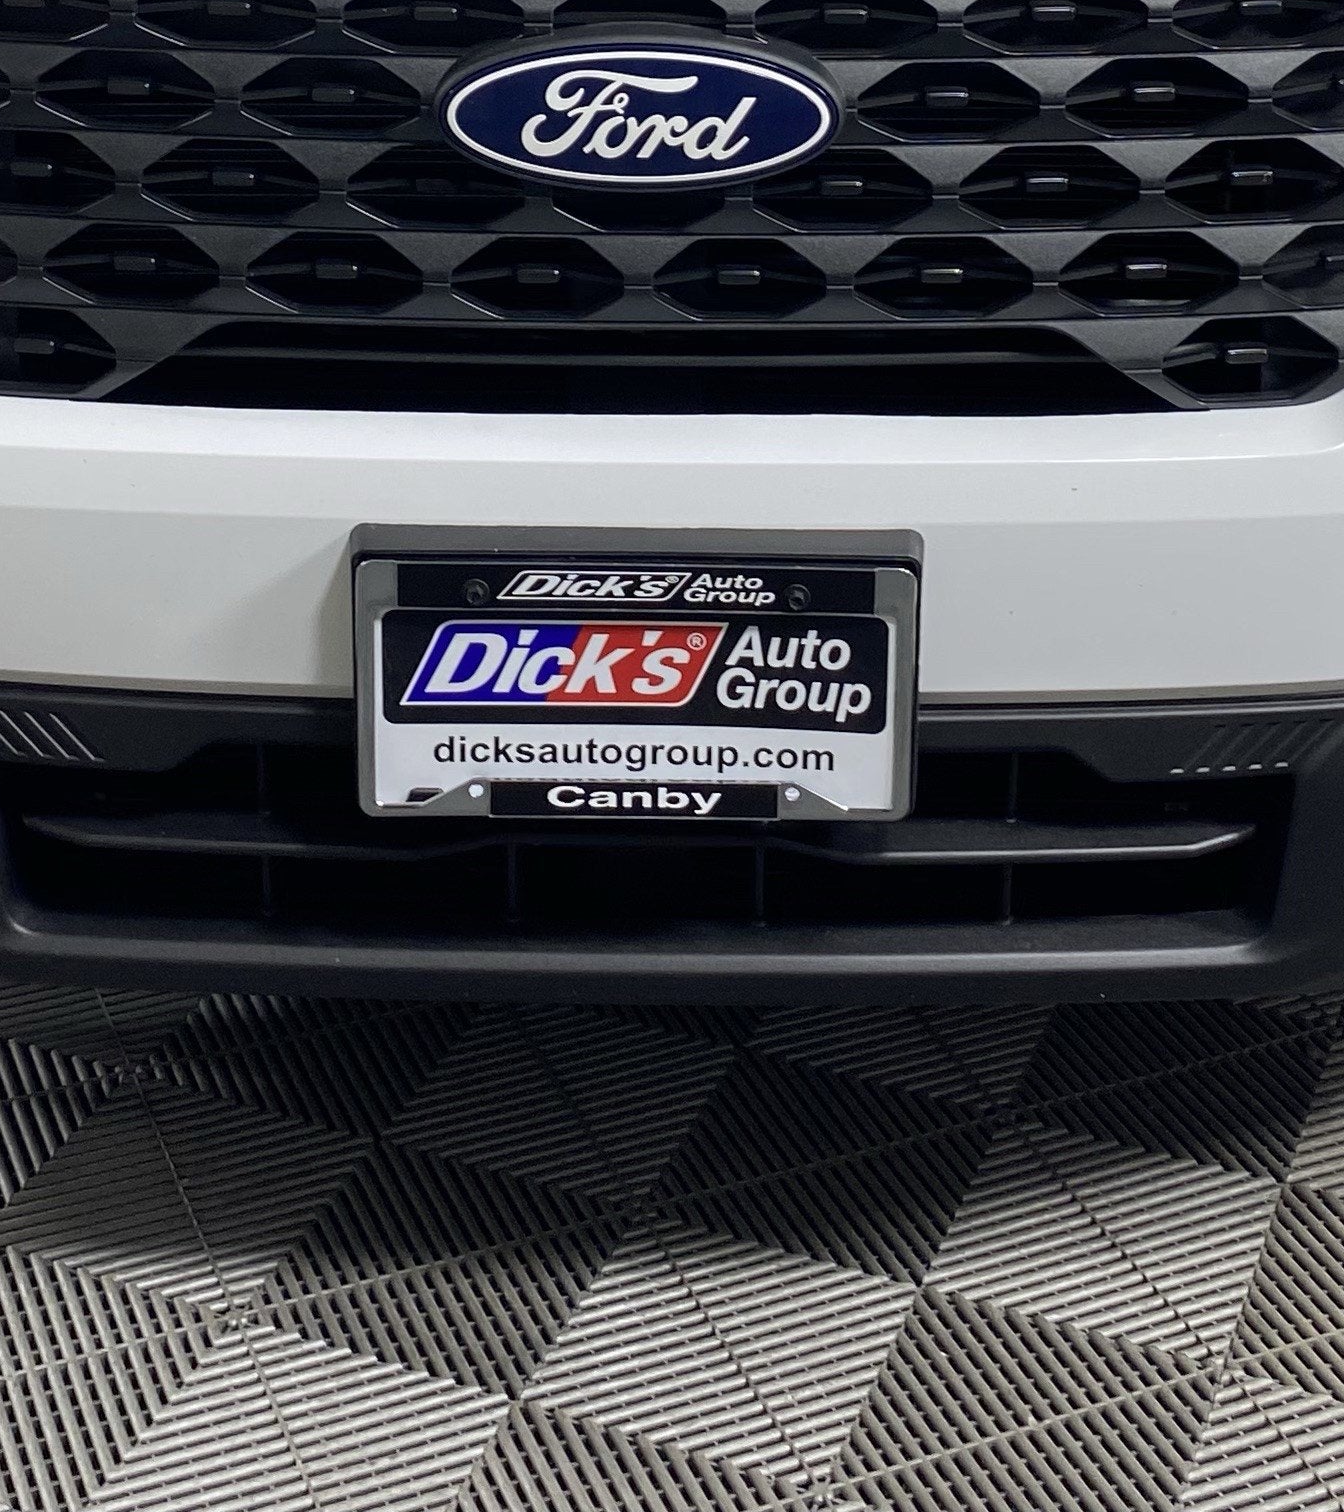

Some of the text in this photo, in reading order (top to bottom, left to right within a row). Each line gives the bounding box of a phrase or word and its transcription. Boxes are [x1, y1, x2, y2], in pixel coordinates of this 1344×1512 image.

[520, 69, 757, 159] Ford
[682, 587, 777, 607] Group
[690, 573, 764, 589] Auto
[724, 624, 852, 671] Auto
[715, 667, 873, 723] Group
[432, 735, 835, 772] dicksautogroup.com
[546, 785, 722, 815] Canby
